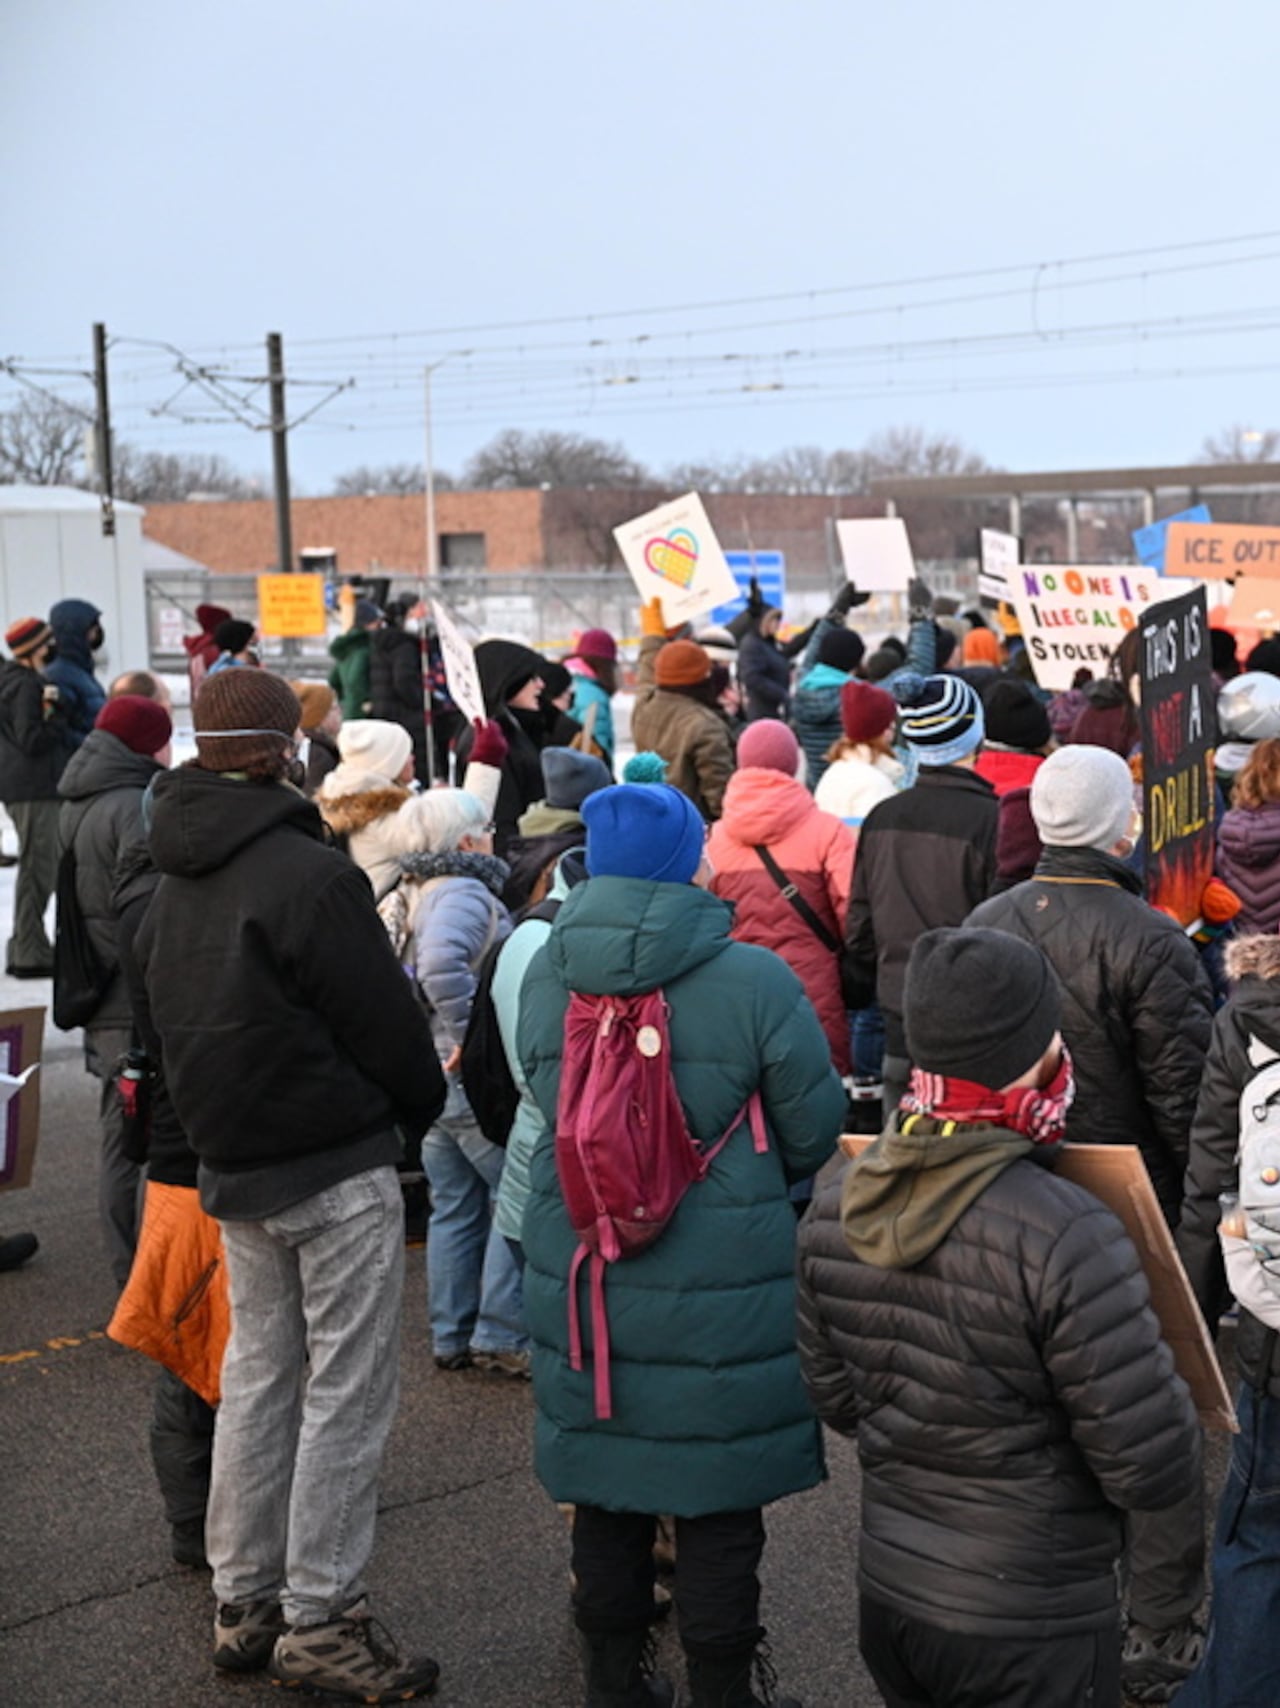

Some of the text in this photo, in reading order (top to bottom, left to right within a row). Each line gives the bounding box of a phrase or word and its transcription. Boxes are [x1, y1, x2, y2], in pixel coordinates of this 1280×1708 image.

[1184, 538, 1224, 564] ICE
[1022, 570, 1058, 597] NO
[1064, 569, 1114, 597] ONE
[1120, 575, 1150, 602] IS
[1031, 603, 1117, 628] ILLEGAL
[1143, 604, 1201, 682] THIS IS
[1150, 683, 1202, 769] NOT A
